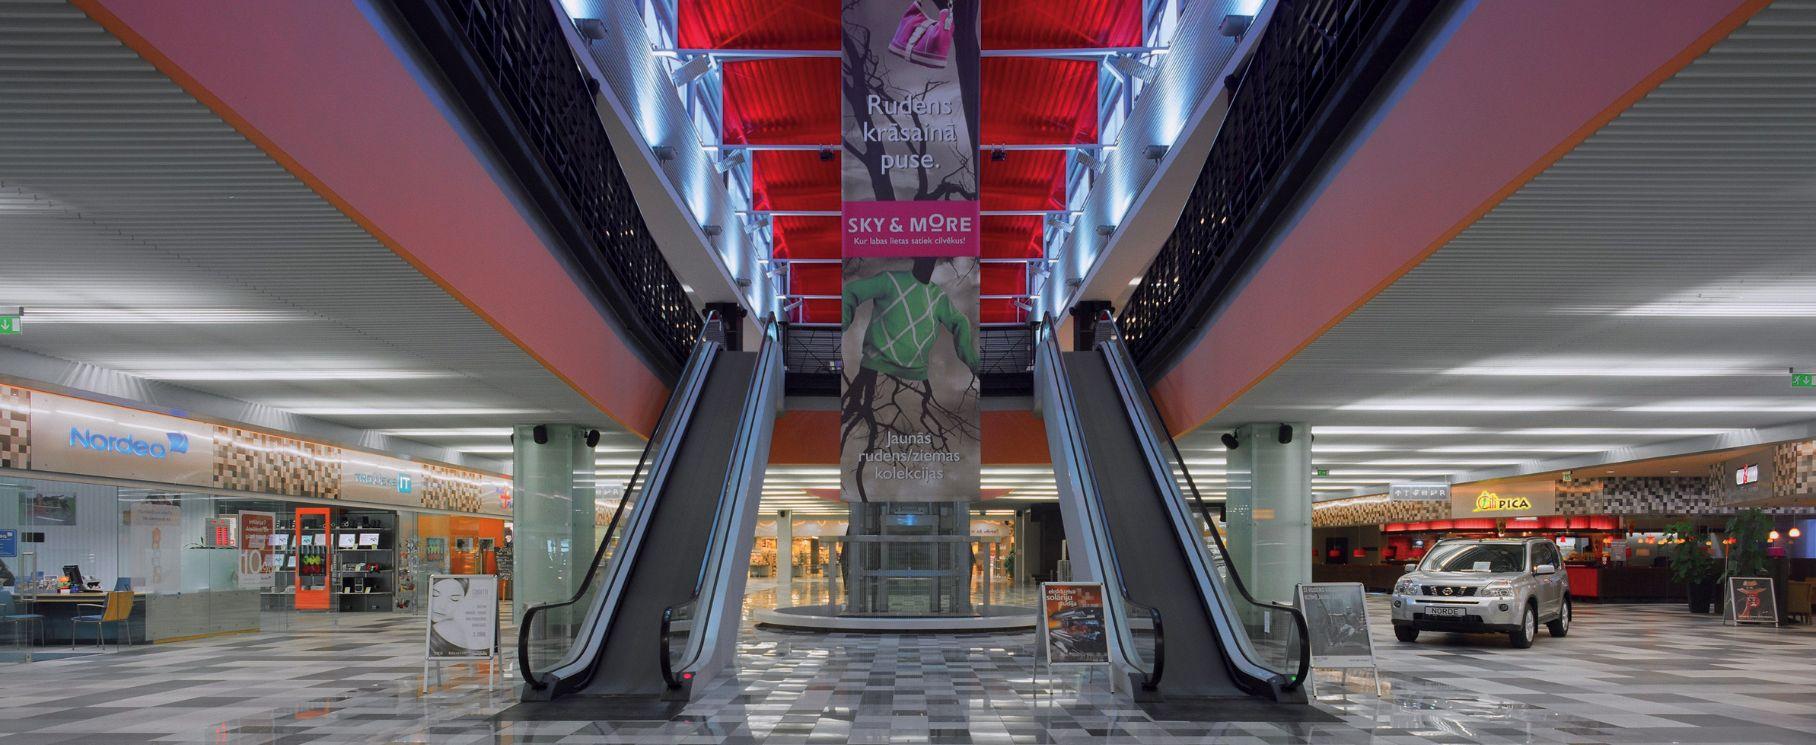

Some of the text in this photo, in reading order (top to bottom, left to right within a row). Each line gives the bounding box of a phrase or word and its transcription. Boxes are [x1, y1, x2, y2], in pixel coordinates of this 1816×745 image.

[867, 94, 953, 115] Rudens
[863, 121, 957, 142] krāsainā
[880, 154, 940, 175] puse.
[848, 213, 972, 233] SKY & MORE
[854, 237, 870, 246] Kur
[870, 236, 888, 246] labas
[890, 236, 909, 246] lietas
[911, 236, 932, 246] satiek
[69, 426, 167, 459] Nordea
[885, 431, 932, 448] Jaunās
[859, 449, 961, 462] rudens/ziemas
[875, 467, 944, 483] kolekcijas
[1499, 499, 1530, 510] PICA
